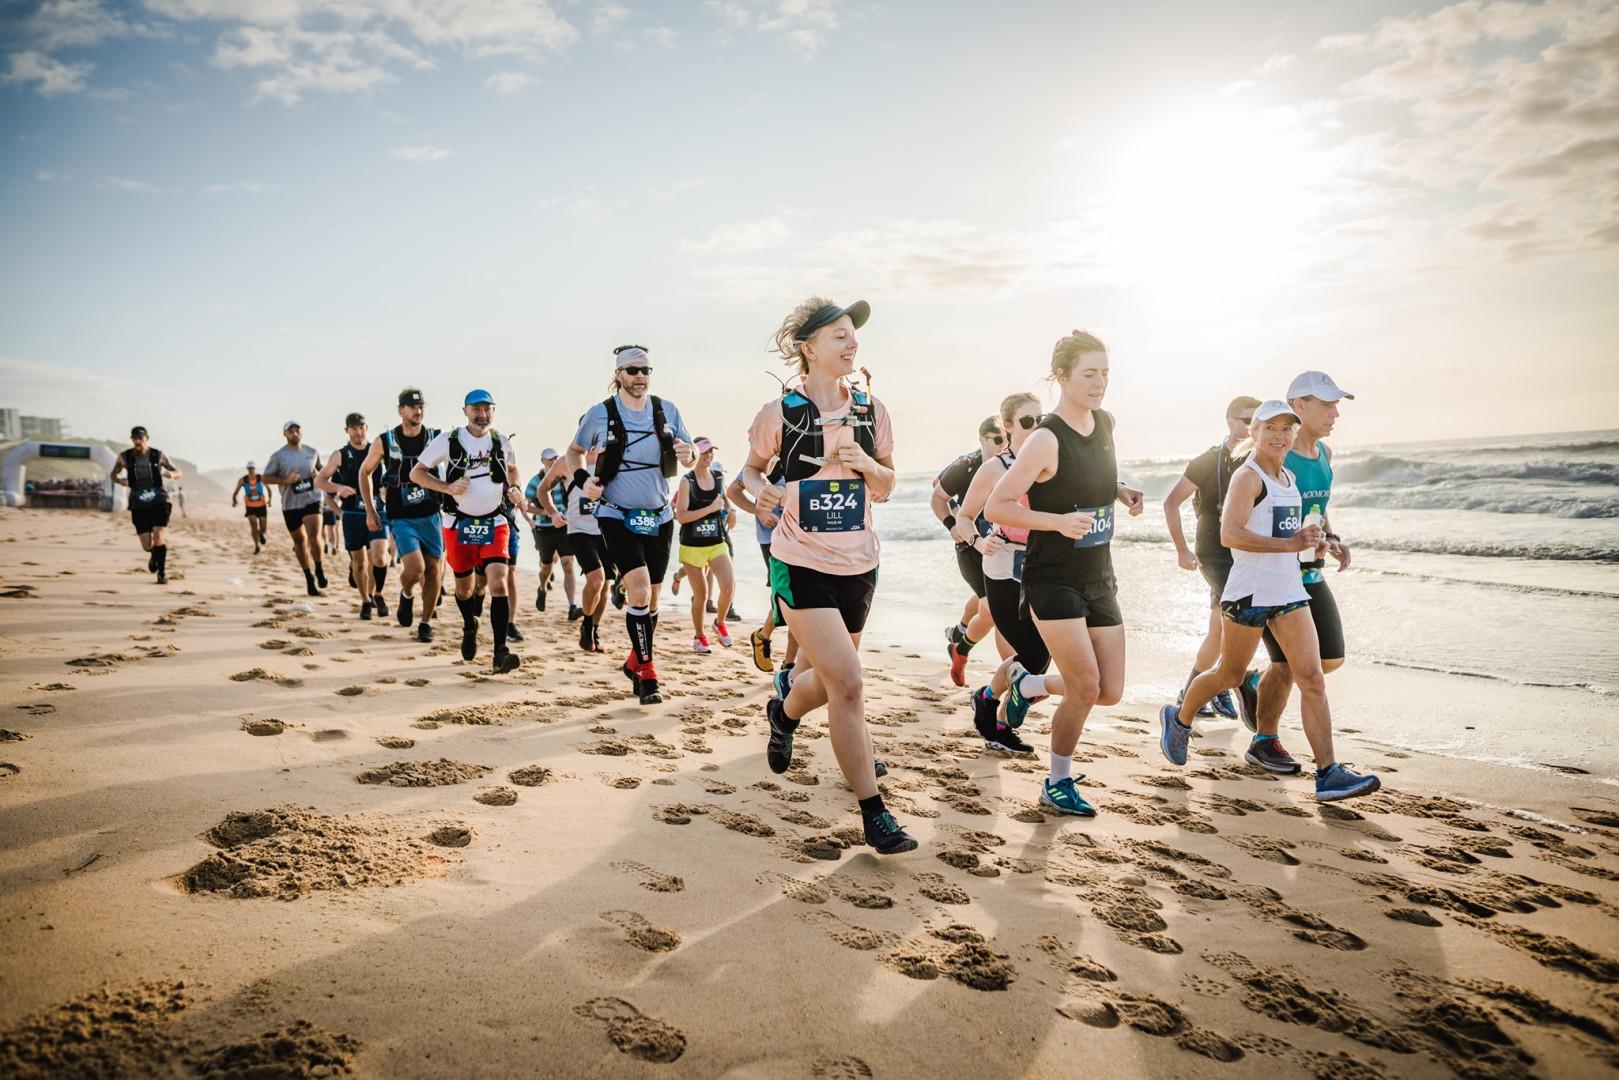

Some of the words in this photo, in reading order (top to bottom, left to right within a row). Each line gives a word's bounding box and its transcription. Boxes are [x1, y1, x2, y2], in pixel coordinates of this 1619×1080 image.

[1302, 490, 1330, 499] ACKMOR
[809, 493, 858, 511] B324
[630, 516, 656, 528] B386
[463, 524, 489, 535] B373
[696, 524, 715, 532] B330
